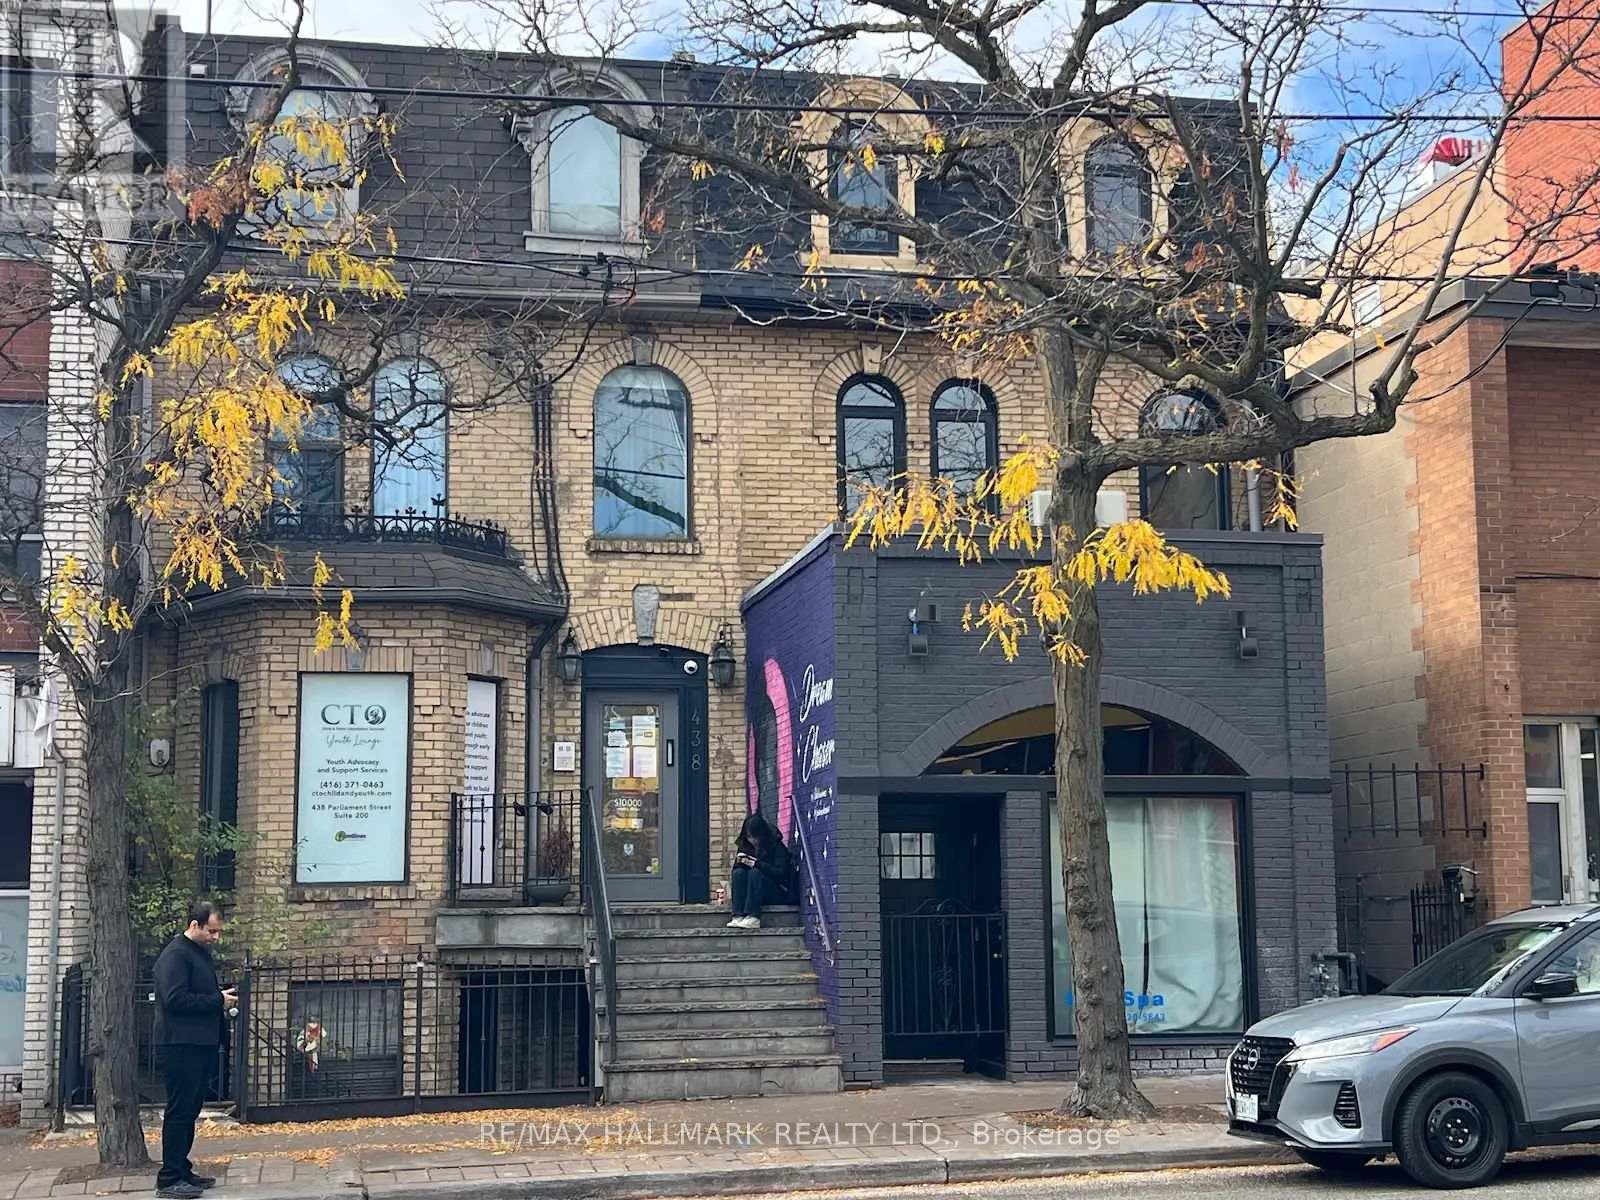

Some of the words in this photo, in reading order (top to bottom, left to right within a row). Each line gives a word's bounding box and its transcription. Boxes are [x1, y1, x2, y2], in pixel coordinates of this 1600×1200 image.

[320, 703, 387, 726] CTO
[691, 708, 702, 770] 438
[347, 760, 380, 768] Advocacy
[331, 767, 359, 775] Support
[320, 781, 342, 789] (416)
[1123, 991, 1164, 1009] Spa
